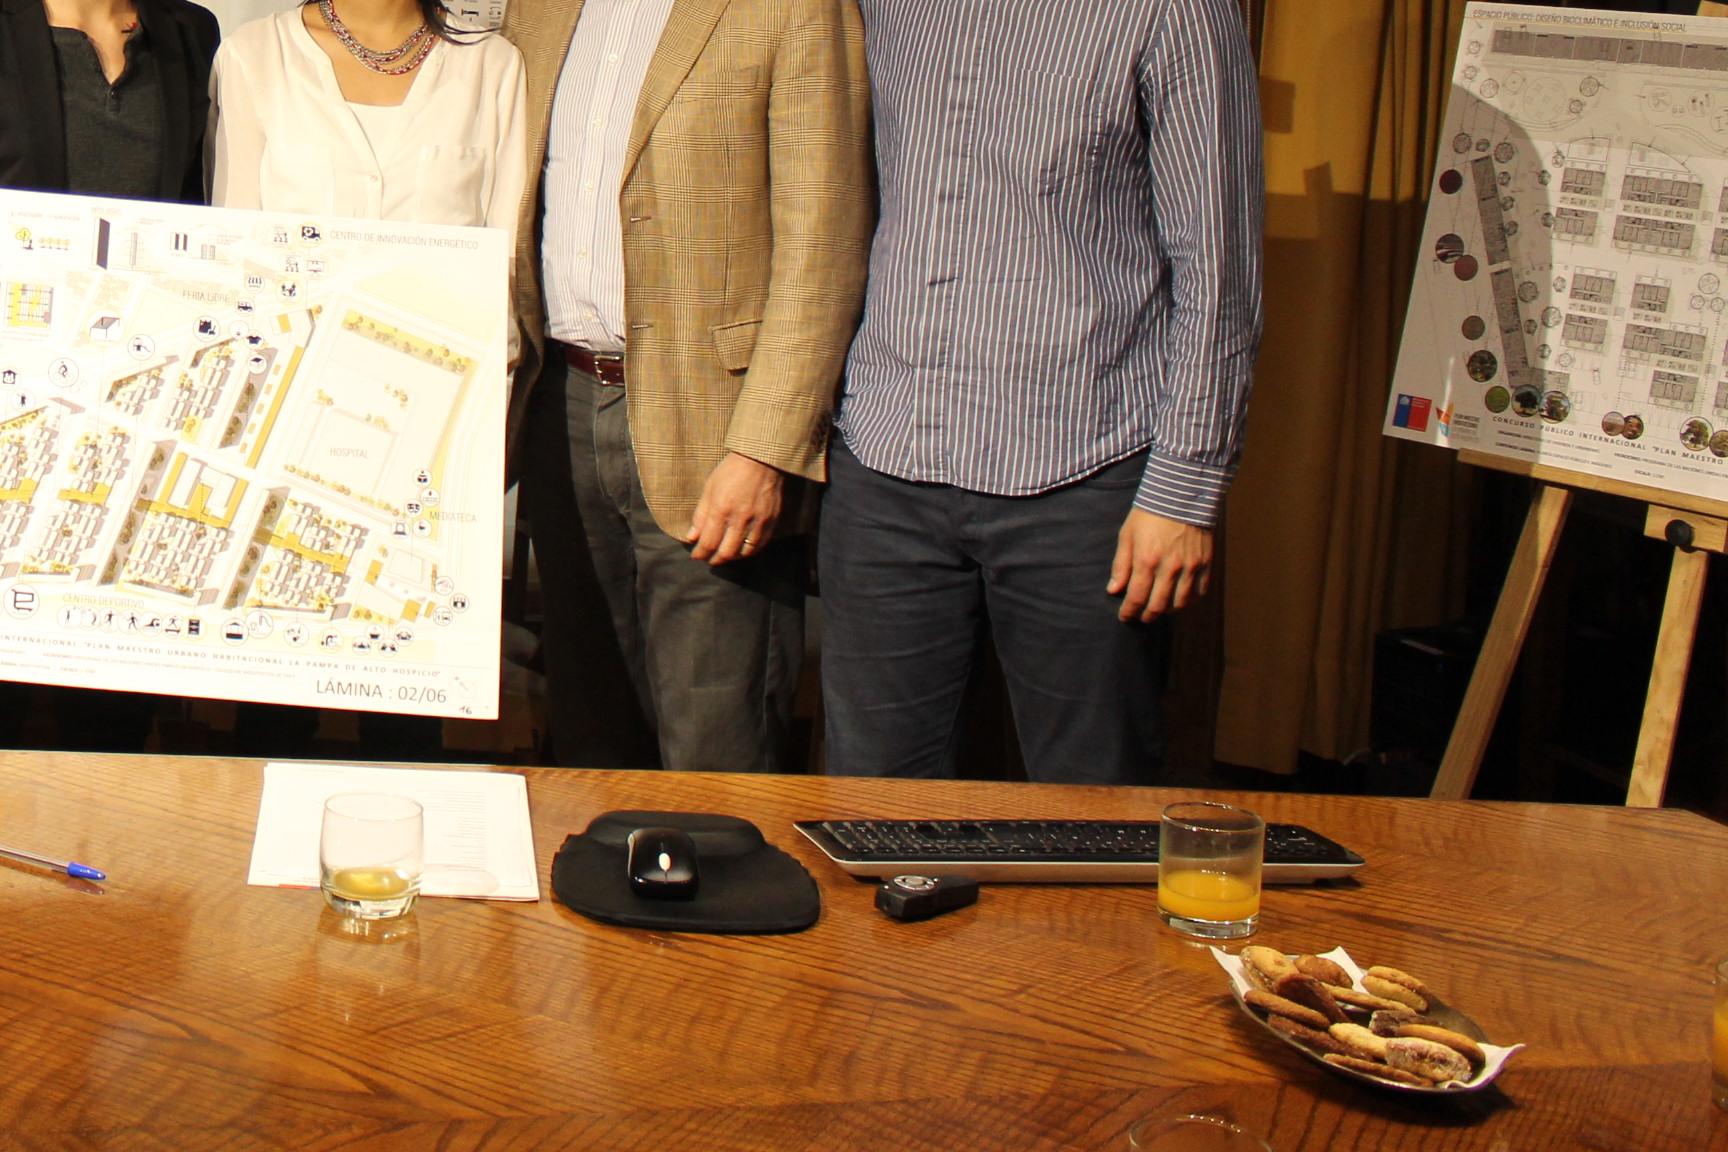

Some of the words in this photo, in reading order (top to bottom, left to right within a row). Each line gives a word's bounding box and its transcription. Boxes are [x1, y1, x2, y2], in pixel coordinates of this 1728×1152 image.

[329, 230, 362, 242] CENTRO
[364, 232, 376, 242] DE
[329, 447, 369, 459] HOSPITAL
[1491, 415, 1535, 429] CONCURSO
[1578, 432, 1646, 451] INTERNACIONAL
[1682, 451, 1724, 466] MAESTRO
[0, 633, 76, 647] INTERNACIONAL
[116, 644, 161, 655] MAESTRO
[167, 649, 207, 658] URBANO
[212, 653, 282, 665] HABITACIONAL
[288, 659, 300, 667] LA
[305, 661, 339, 669] PAMPA
[363, 665, 387, 673] ALTO
[316, 677, 384, 699] LÁMINA
[397, 685, 447, 704] 02/06
